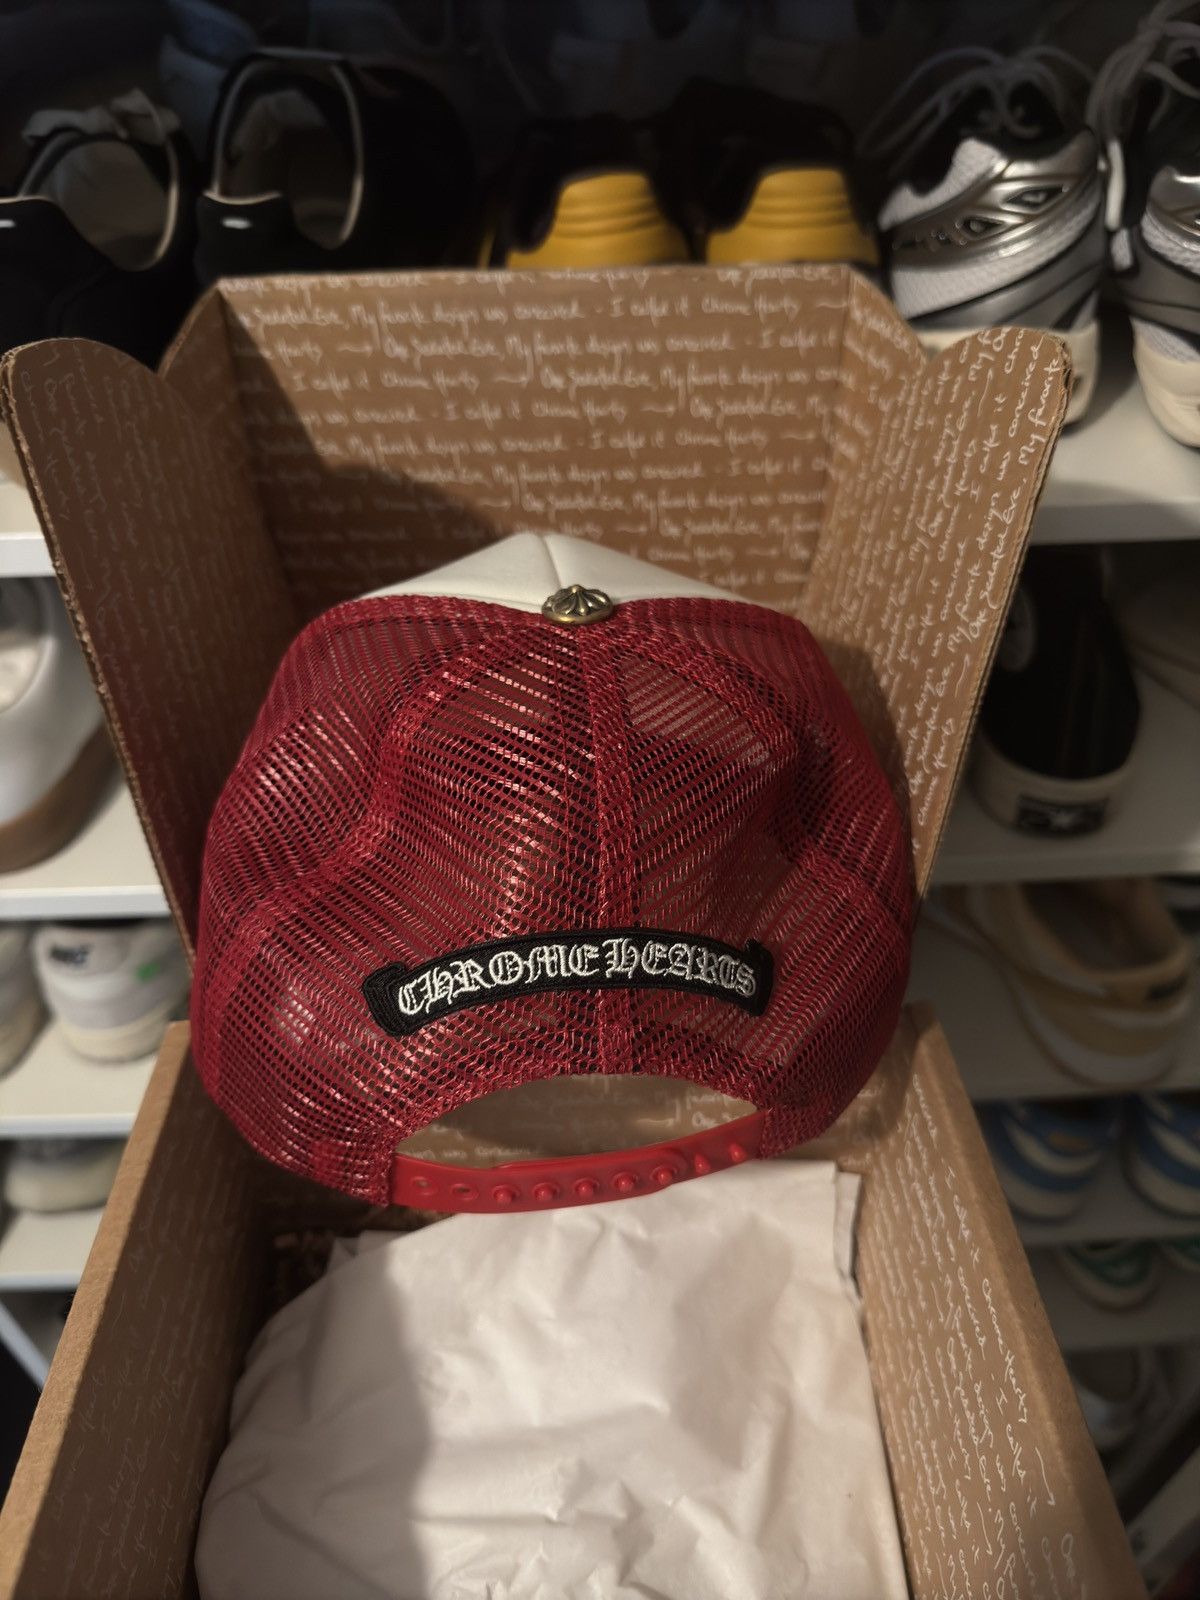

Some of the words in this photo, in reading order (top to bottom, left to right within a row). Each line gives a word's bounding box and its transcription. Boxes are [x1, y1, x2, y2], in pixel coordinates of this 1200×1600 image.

[992, 393, 1007, 412] it
[1019, 435, 1047, 465] My
[398, 944, 600, 1015] CHROME
[602, 937, 757, 997] HEARTS
[996, 1387, 1007, 1415] I
